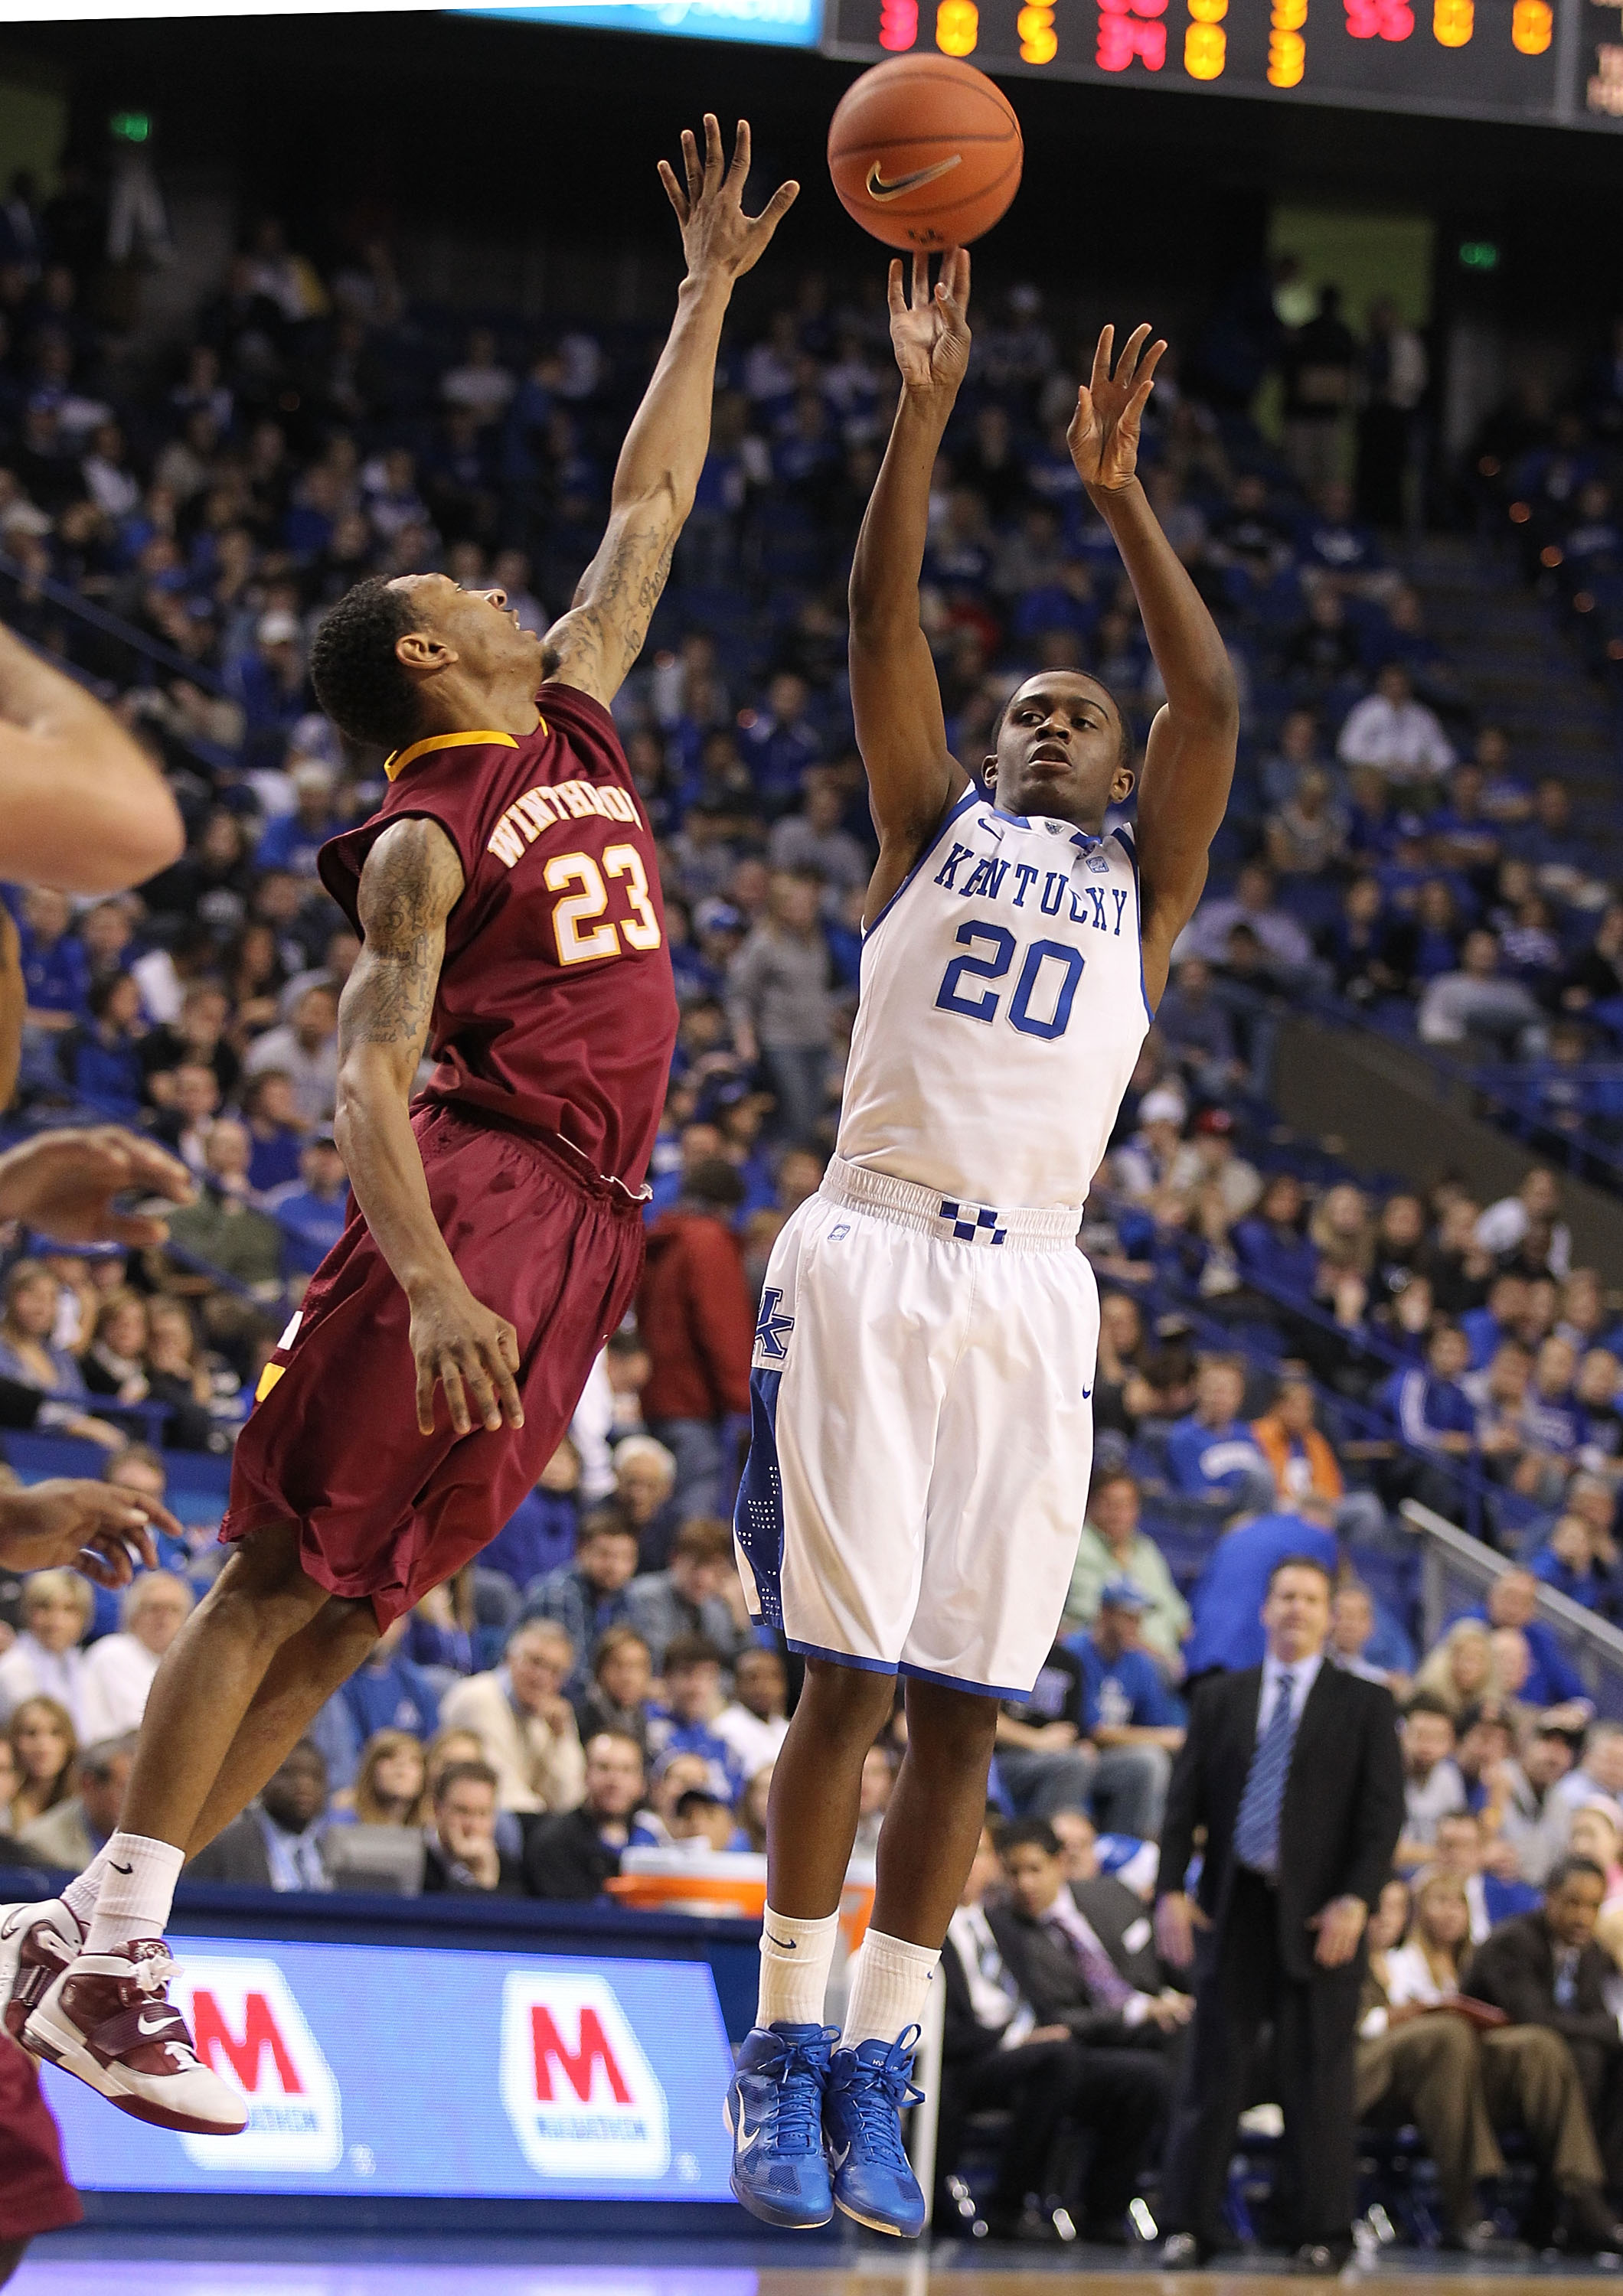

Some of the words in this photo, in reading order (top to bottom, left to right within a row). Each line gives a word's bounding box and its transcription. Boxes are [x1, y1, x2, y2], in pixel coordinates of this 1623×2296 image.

[543, 843, 661, 967] 23
[933, 842, 1128, 936] KENTUCKY
[933, 919, 1086, 1042] 20
[193, 1990, 304, 2094] M
[531, 2005, 633, 2104] M
